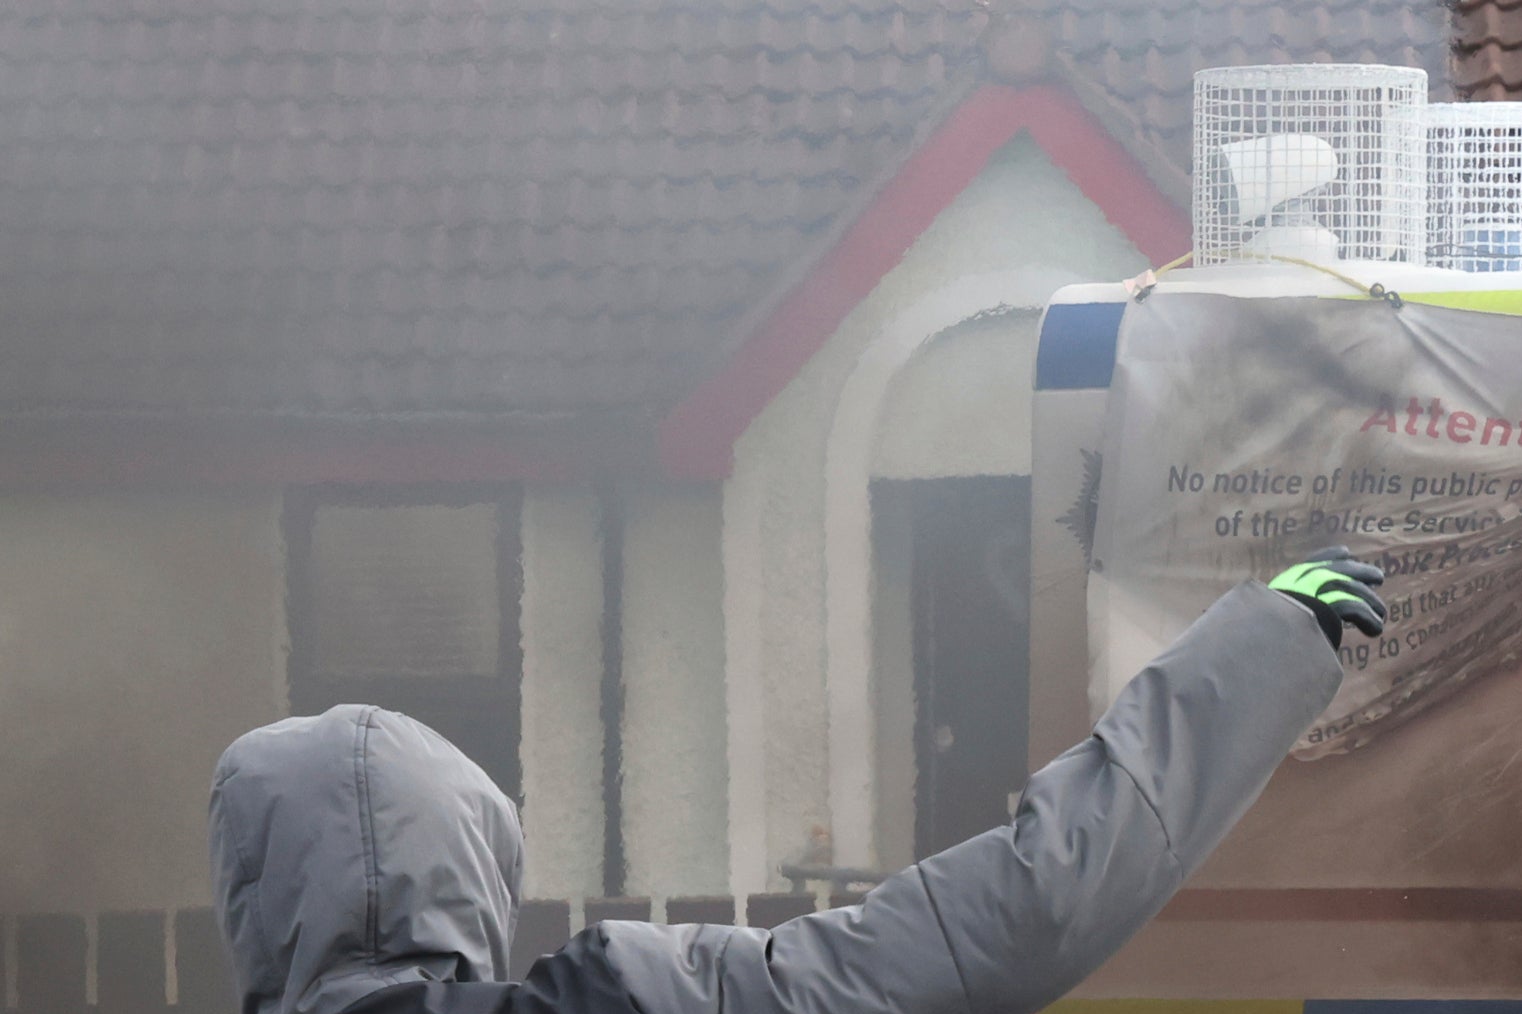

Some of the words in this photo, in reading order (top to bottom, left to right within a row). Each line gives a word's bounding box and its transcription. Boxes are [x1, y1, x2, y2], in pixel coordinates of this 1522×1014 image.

[1167, 465, 1204, 493] No
[1212, 468, 1303, 495] notice
[1312, 467, 1342, 495] of
[1350, 467, 1402, 495] this
[1410, 471, 1501, 501] public
[1215, 509, 1243, 537] of
[1250, 509, 1297, 537] the
[1308, 507, 1394, 534] Police
[1419, 584, 1458, 612] that
[1378, 635, 1400, 660] to
